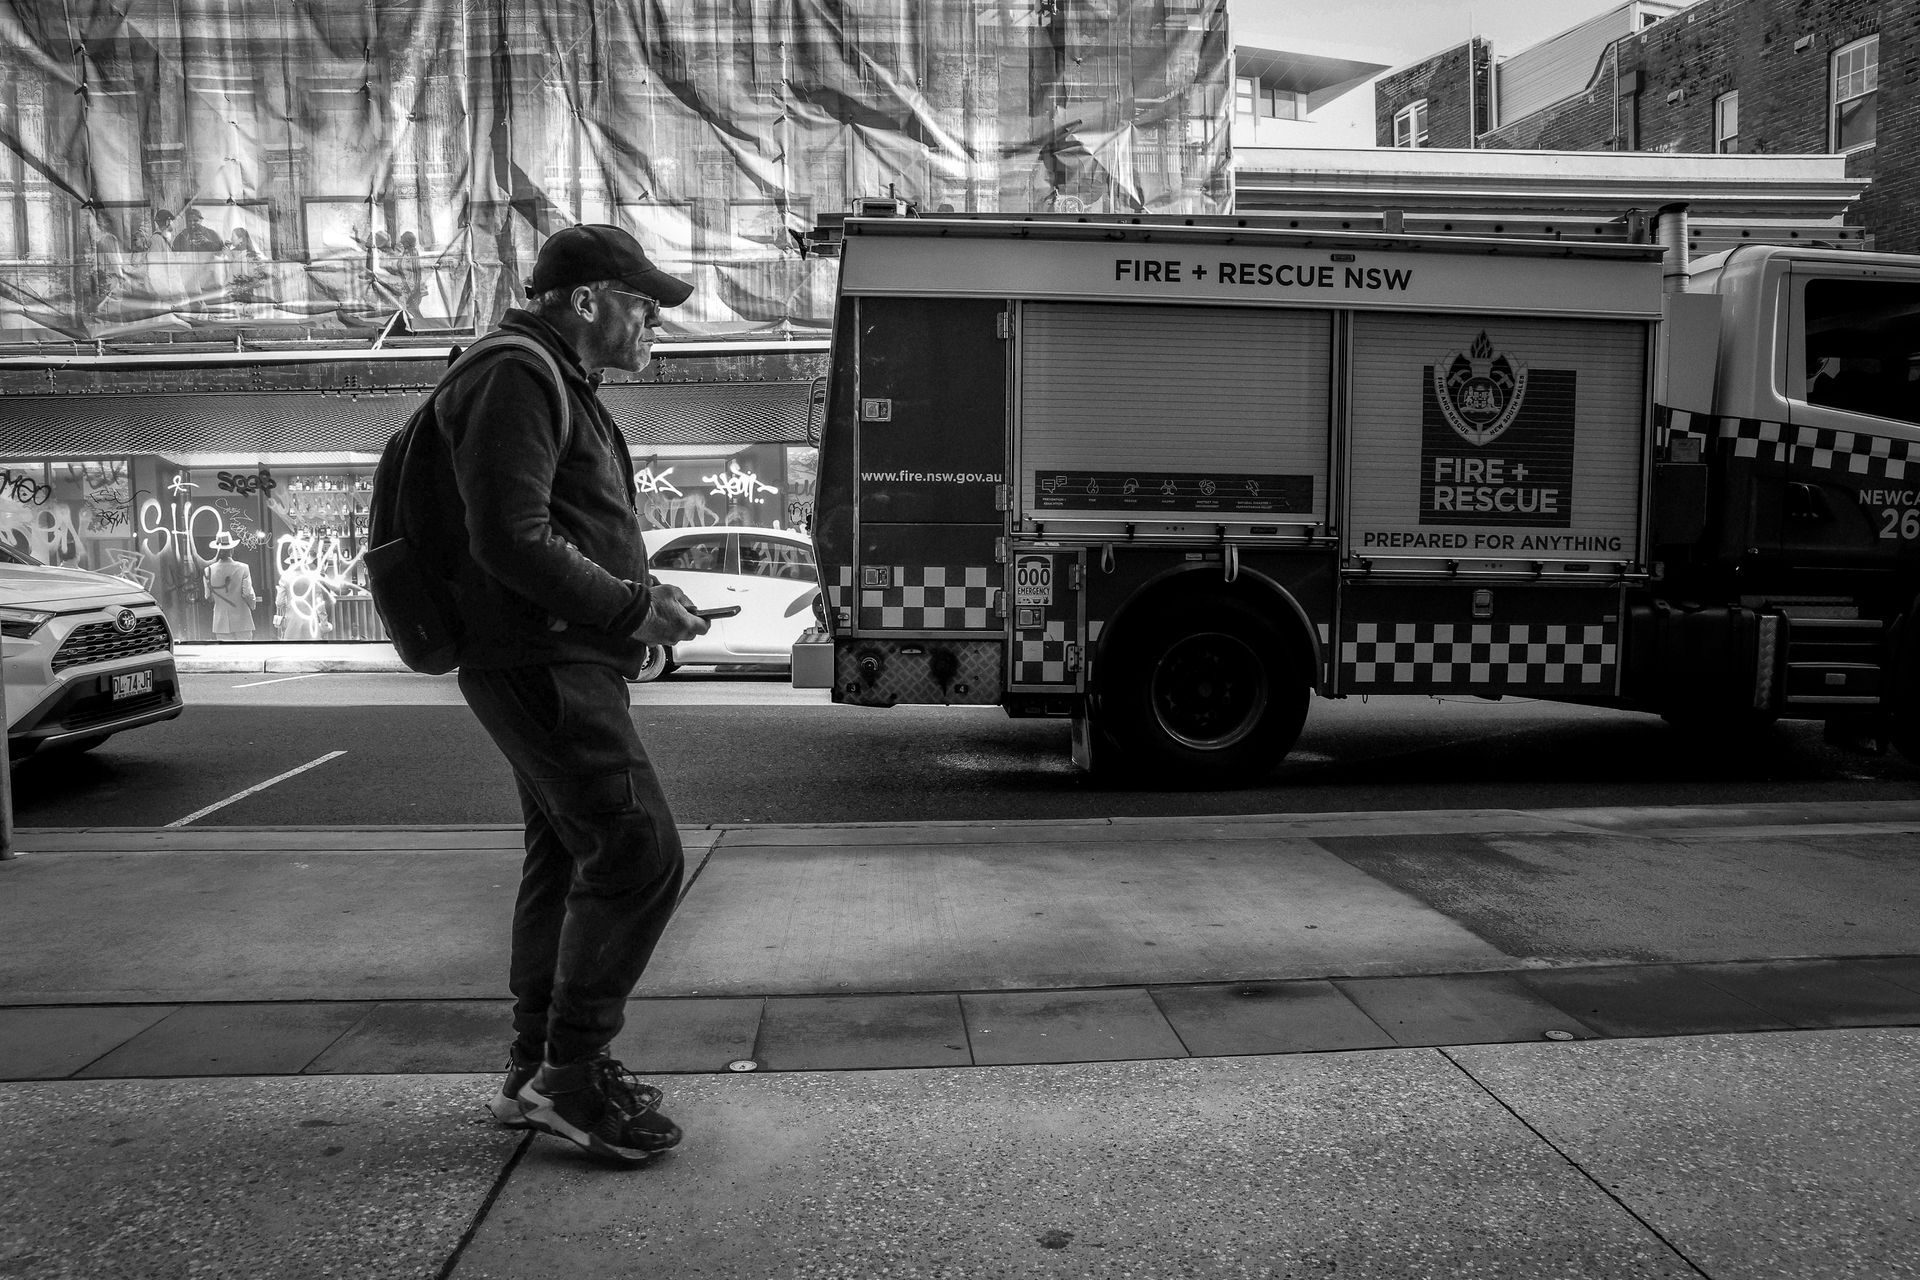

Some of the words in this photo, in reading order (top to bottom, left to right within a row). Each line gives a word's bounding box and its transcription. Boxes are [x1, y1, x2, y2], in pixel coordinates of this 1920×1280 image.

[1115, 259, 1181, 282] FIRE
[1192, 264, 1207, 280] +
[1218, 262, 1334, 288] RESCUE
[1344, 267, 1412, 291] NSW
[1437, 377, 1445, 393] FIRE
[1441, 396, 1450, 411] AND
[1447, 411, 1470, 435] RESCUE
[1489, 424, 1504, 436] NEW
[1503, 401, 1519, 423] SOUTH
[1516, 375, 1525, 400] WALES
[861, 470, 1002, 484] www.fire.nsw.gov.au
[1434, 457, 1504, 484] FIRE
[1511, 463, 1528, 481] +
[1434, 486, 1558, 513] RESCUE
[1364, 532, 1467, 549] PREPARED
[1475, 534, 1514, 550] FOR
[1521, 535, 1622, 551] ANYTHING
[1018, 568, 1050, 586] 000
[1017, 587, 1050, 595] EMERGENCY
